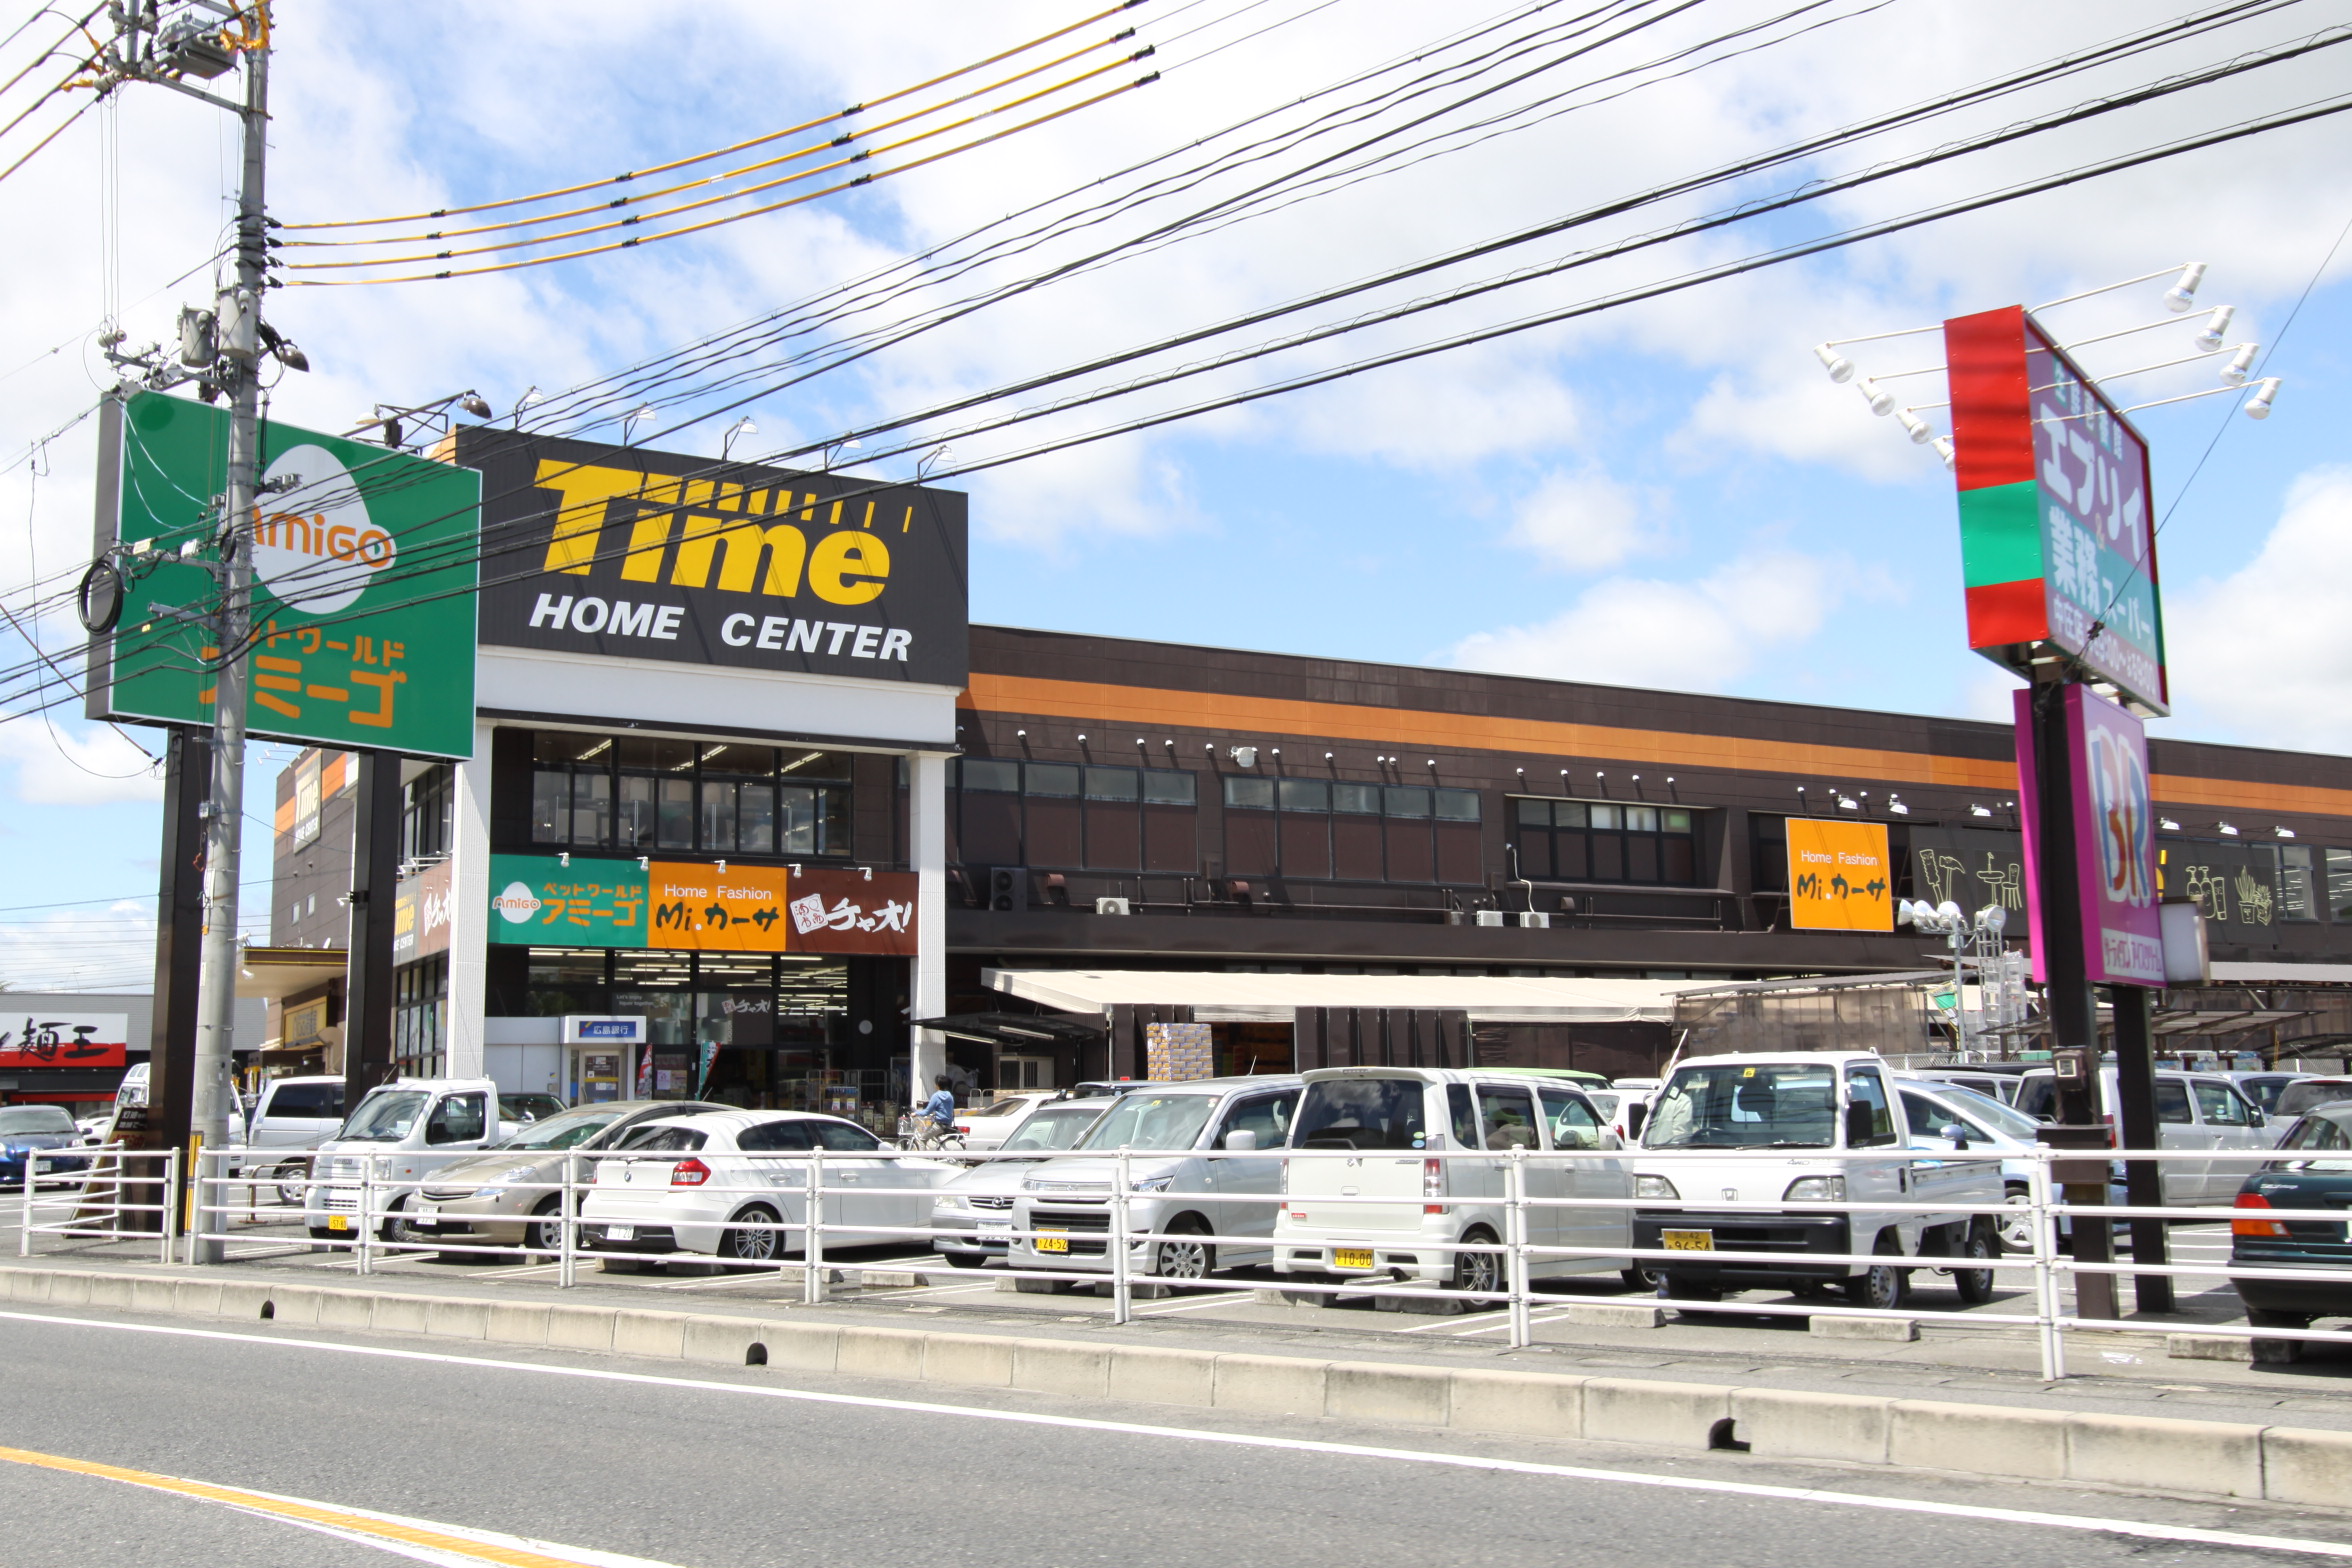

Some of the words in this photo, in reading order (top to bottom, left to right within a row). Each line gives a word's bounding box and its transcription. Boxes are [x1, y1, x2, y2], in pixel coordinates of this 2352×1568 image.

[534, 459, 891, 606] Time
[2049, 505, 2151, 643] 業務スーパー
[529, 593, 686, 641] HOME
[721, 613, 913, 663] CENTER
[1801, 850, 1832, 864] Home
[1838, 852, 1878, 866] Fashion
[543, 882, 642, 898] ペットワールド
[665, 884, 707, 899] Home
[717, 885, 772, 901] Fashion
[542, 898, 643, 927] アミーゴ
[0, 1016, 110, 1062] 麺王
[593, 1025, 629, 1036] 広島銀行
[1043, 1238, 1067, 1250] 24-52
[1343, 1252, 1372, 1266] 10-00
